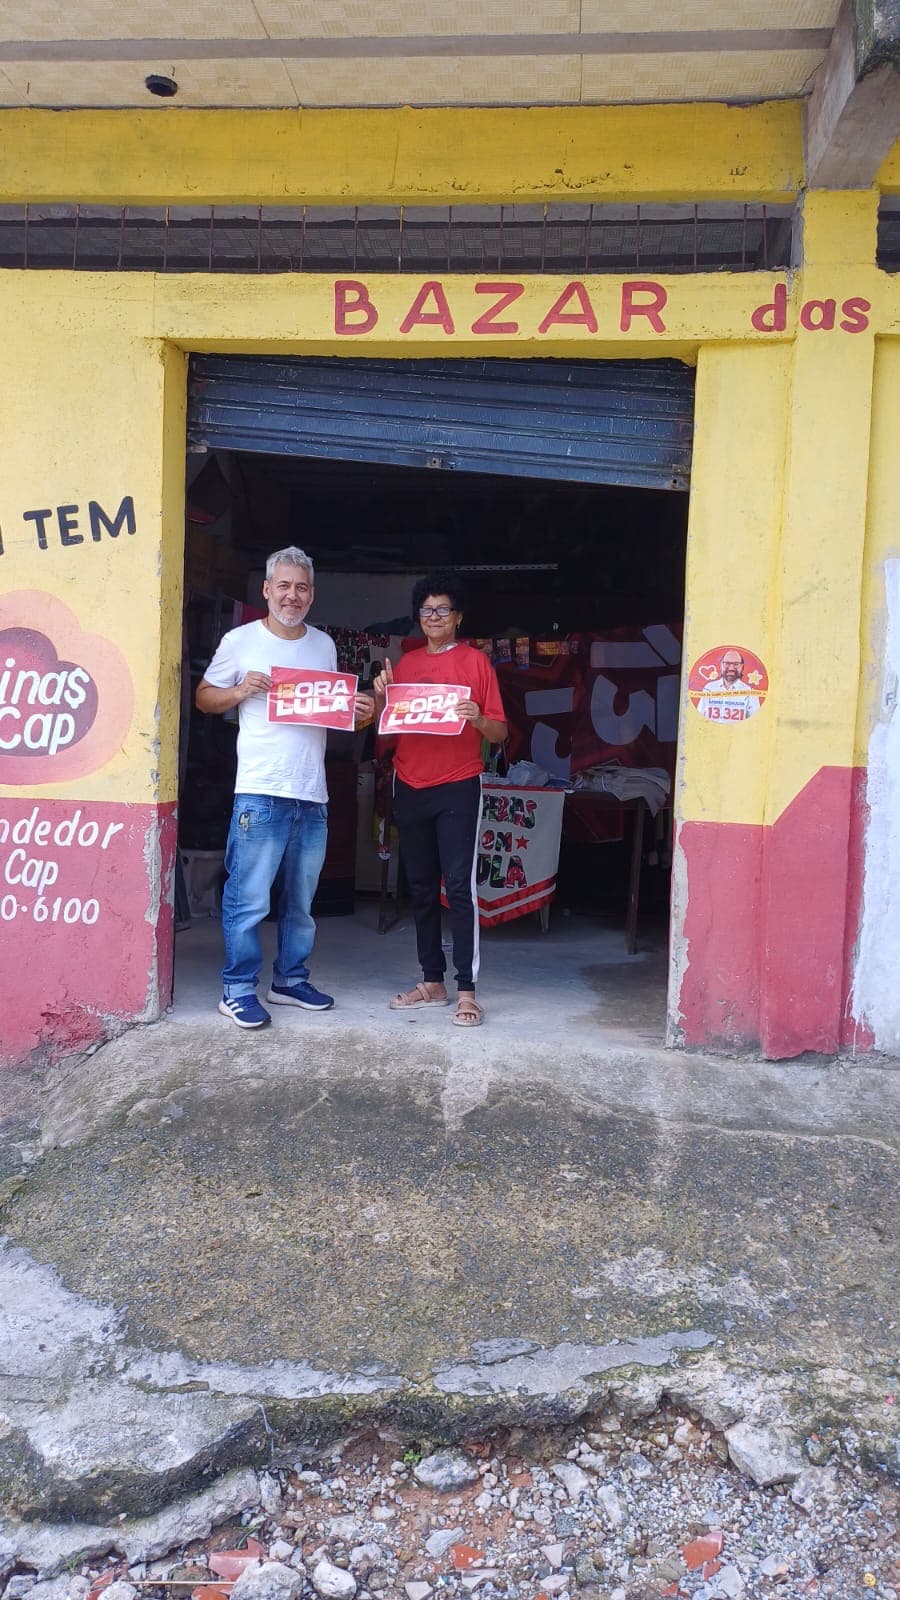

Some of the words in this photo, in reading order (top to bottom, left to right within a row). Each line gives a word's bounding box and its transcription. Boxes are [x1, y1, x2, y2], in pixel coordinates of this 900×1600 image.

[334, 280, 667, 335] BAZAR
[751, 282, 872, 334] das
[23, 496, 136, 550] TEM
[276, 696, 350, 717] LULA
[277, 680, 350, 699] BORA
[0, 706, 75, 756] Cap
[387, 708, 460, 727] LULA
[4, 848, 59, 895] Cap
